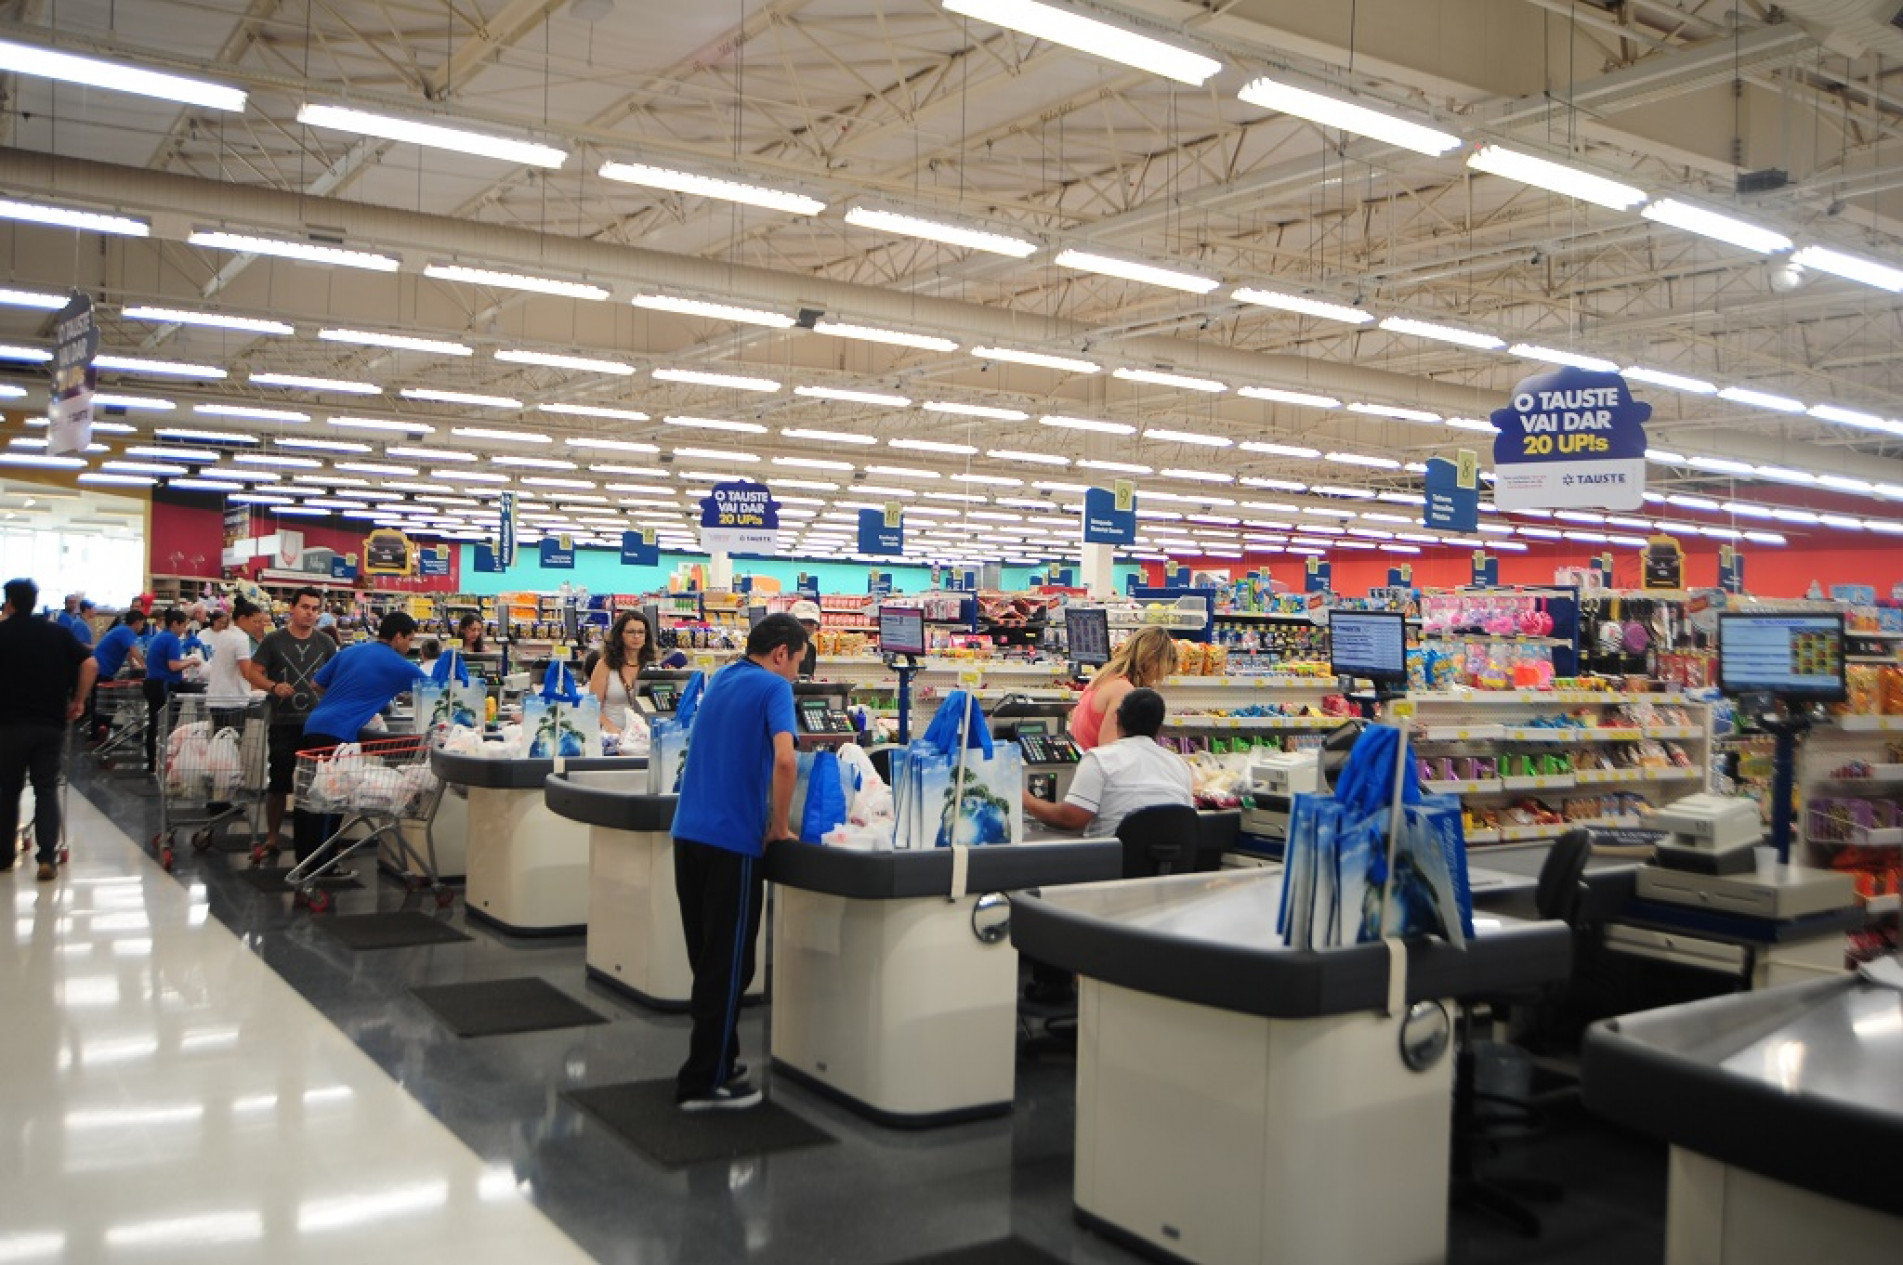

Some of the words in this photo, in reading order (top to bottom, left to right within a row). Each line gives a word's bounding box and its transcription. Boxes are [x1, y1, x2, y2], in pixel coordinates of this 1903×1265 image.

[1514, 393, 1534, 413] O
[1538, 387, 1618, 410] TAUSTE
[1520, 413, 1558, 433] VAI
[1563, 410, 1613, 431] DAR
[1523, 434, 1553, 454] 20
[1576, 473, 1626, 484] TAUSTE
[715, 490, 726, 501] O
[728, 490, 769, 502] TAUSTE
[718, 502, 738, 513] VAI
[740, 502, 765, 514] DAR
[719, 513, 735, 525] 20
[295, 643, 311, 662] Y
[292, 692, 309, 711] C
